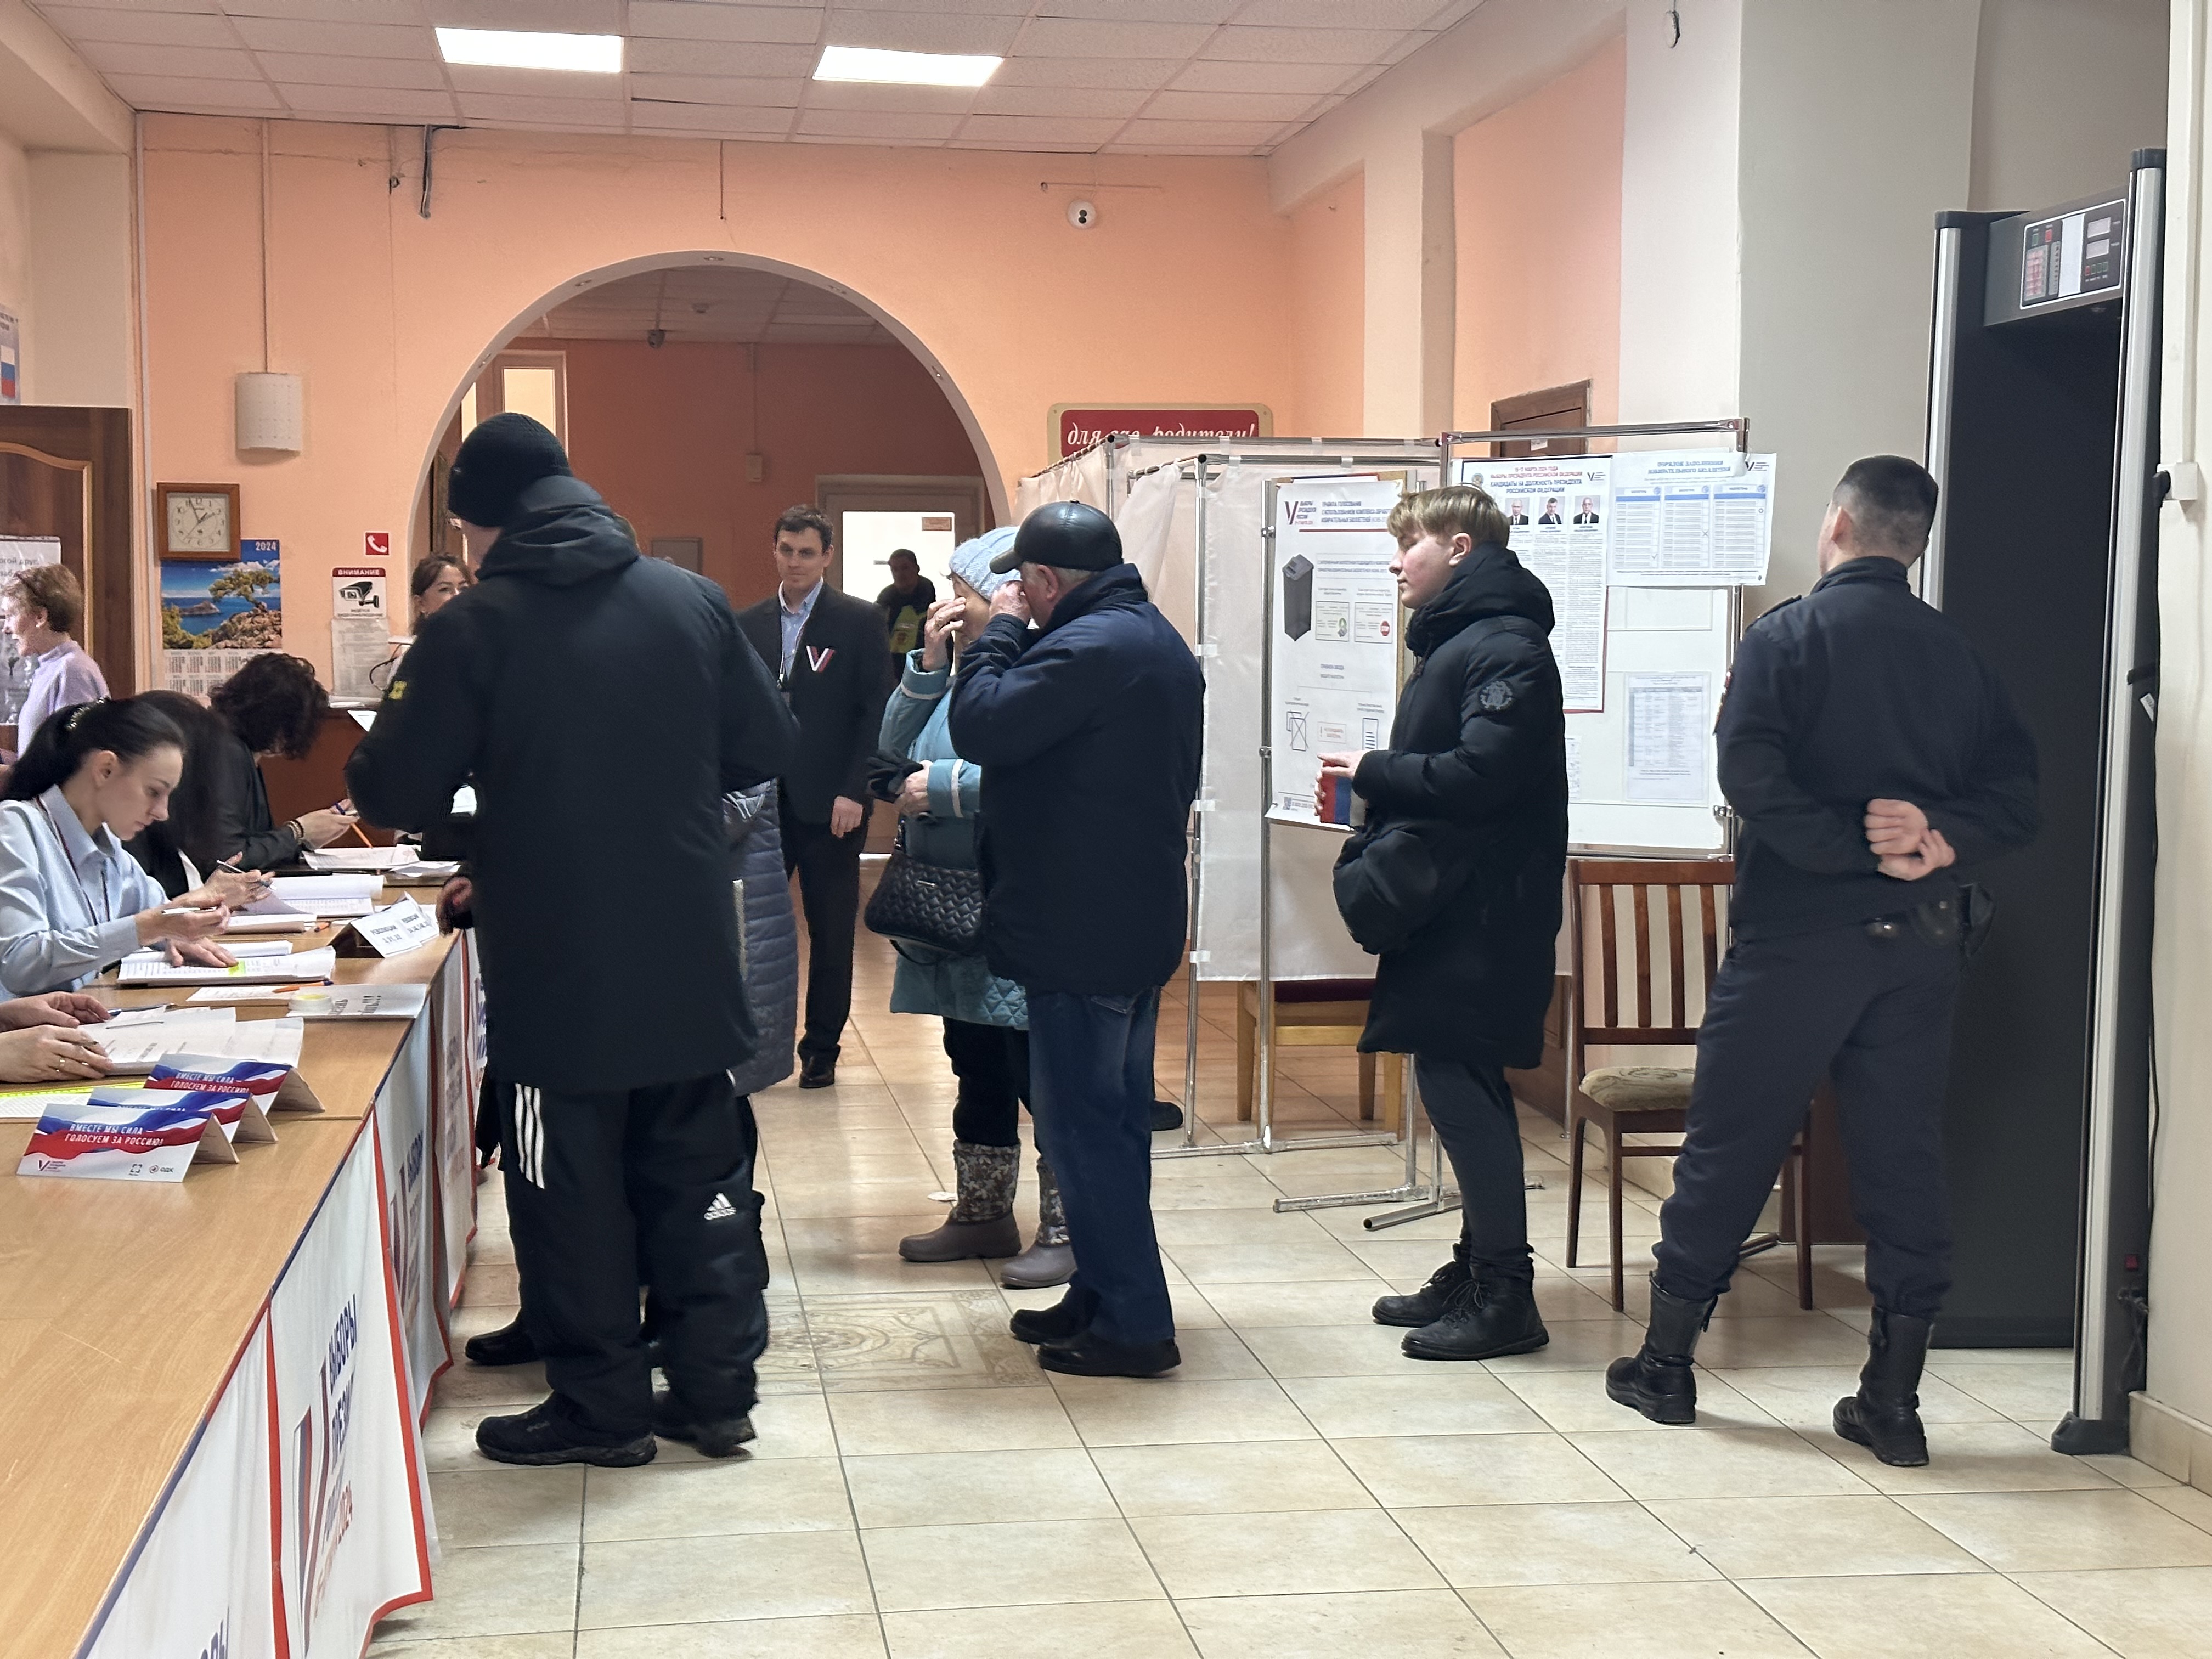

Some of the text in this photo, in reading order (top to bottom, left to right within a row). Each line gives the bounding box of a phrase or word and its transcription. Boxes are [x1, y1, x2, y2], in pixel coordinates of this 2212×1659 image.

[255, 541, 276, 551] 2024
[175, 1071, 201, 1081] ВМЕСТЕ
[204, 1074, 215, 1082] МЫ
[216, 1075, 234, 1084] СИЛА
[170, 1080, 206, 1091] ГОЛОСУЕМ
[70, 1124, 102, 1133] ВМЕСТЕ
[121, 1126, 143, 1135] СИЛА
[65, 1133, 110, 1143] ГОЛОСУЕМ
[124, 1137, 164, 1146] РОССИЮ!
